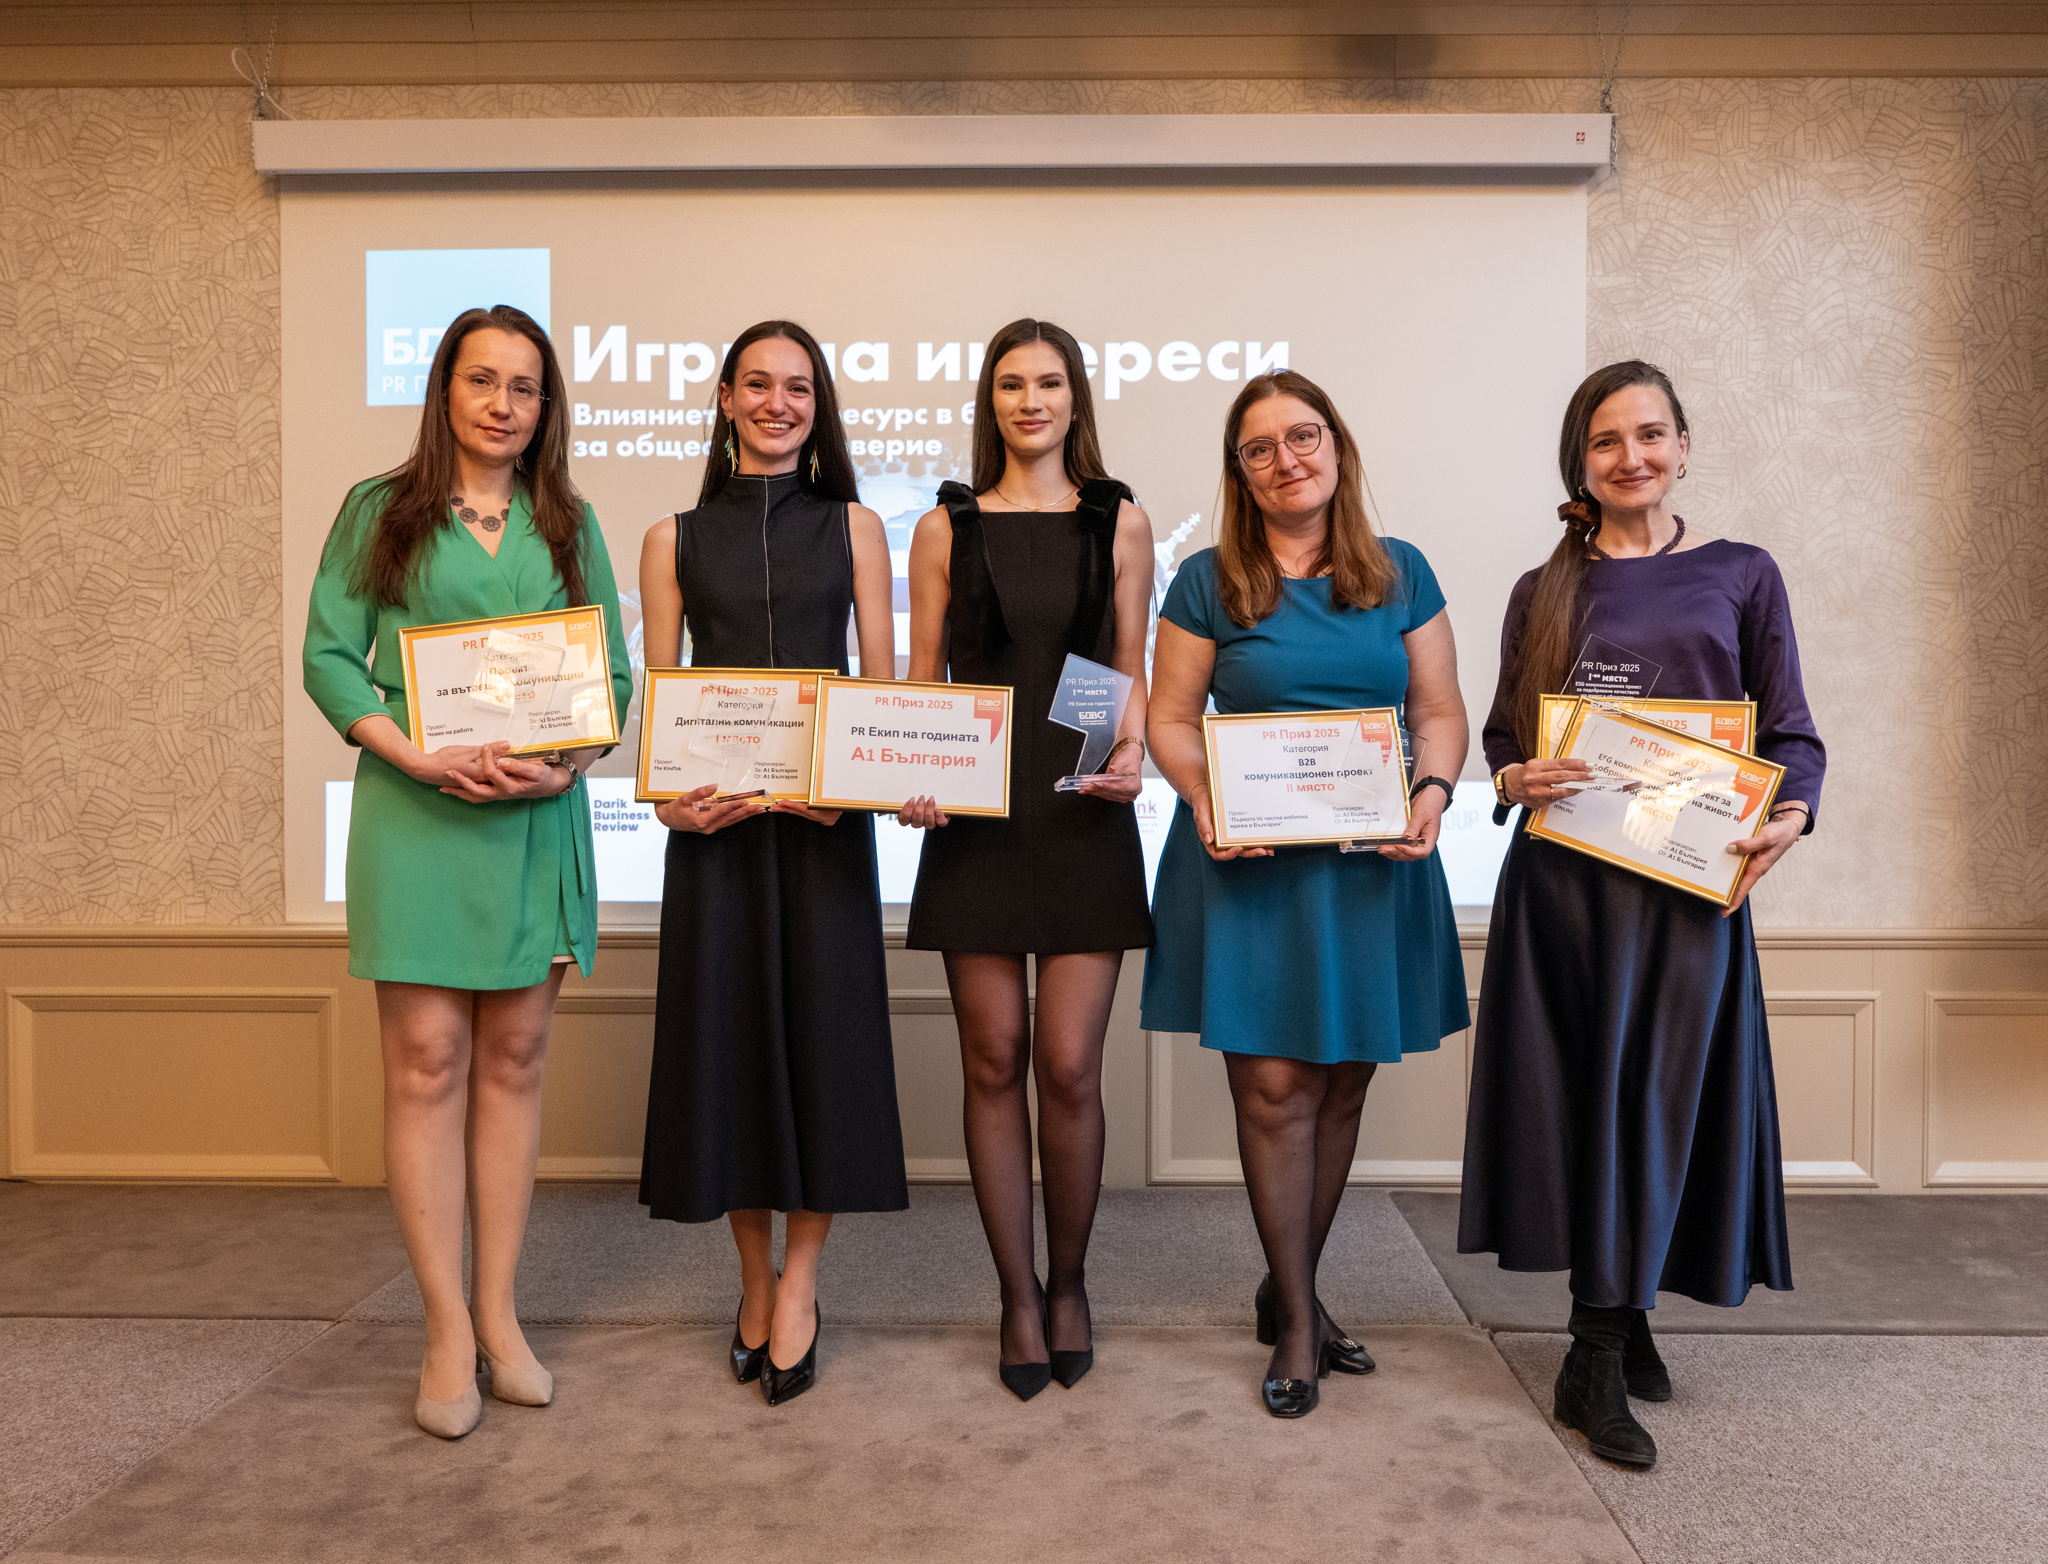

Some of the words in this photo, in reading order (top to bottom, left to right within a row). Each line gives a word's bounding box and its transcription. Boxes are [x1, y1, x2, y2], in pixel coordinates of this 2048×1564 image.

[573, 325, 735, 400] Игр
[382, 376, 406, 393] PR
[839, 407, 927, 431] есурс
[936, 408, 953, 424] в
[573, 440, 608, 457] за
[847, 439, 942, 462] верие
[462, 639, 477, 650] PR
[1581, 661, 1594, 670] PR
[1595, 662, 1618, 672] Приз
[1619, 663, 1640, 673] 2025
[436, 688, 449, 698] за
[513, 671, 584, 687] омуникации
[1065, 678, 1077, 686] PR
[1078, 678, 1098, 687] Приз
[1098, 677, 1117, 685] 2025
[1601, 675, 1629, 683] място
[752, 687, 778, 696] 2025
[718, 701, 763, 711] Категория
[875, 696, 889, 706] PR
[892, 697, 924, 709] Приз
[927, 700, 953, 710] 2025
[851, 726, 865, 736] PR
[869, 727, 900, 738] Екип
[903, 731, 918, 739] на
[921, 731, 979, 742] годината
[1262, 730, 1277, 740] PR
[1279, 729, 1312, 741] Приз
[1314, 728, 1341, 738] 2025
[1629, 735, 1646, 749] PR
[1283, 745, 1329, 754] Категория
[851, 746, 875, 762] А1
[881, 748, 976, 770] България
[1244, 767, 1334, 782] комуникационен
[1296, 783, 1335, 793] място
[593, 797, 628, 809] Darik
[1691, 799, 1703, 809] на
[1703, 804, 1733, 819] живот
[1720, 798, 1732, 807] за
[593, 810, 650, 821] Business
[593, 821, 639, 832] Review
[1676, 856, 1706, 871] България
[1678, 849, 1708, 865] България
